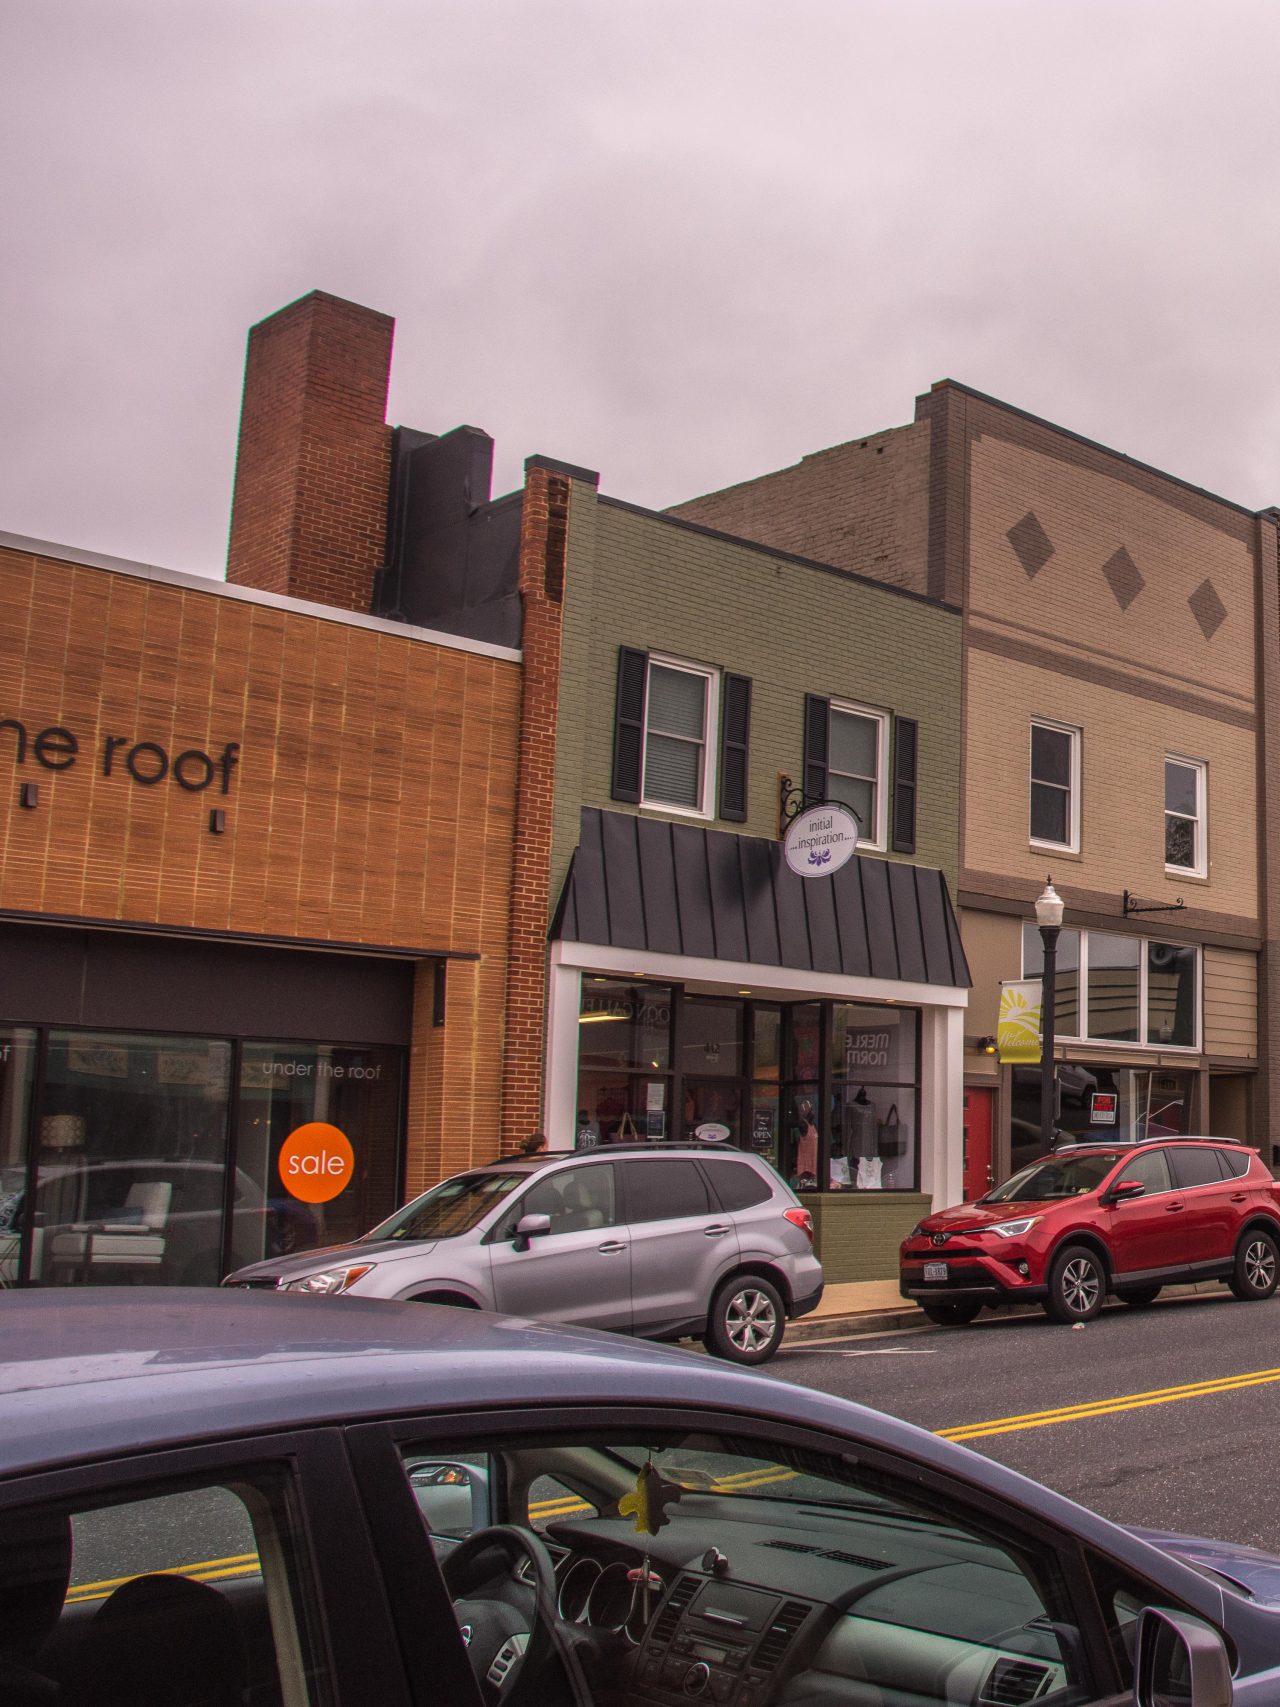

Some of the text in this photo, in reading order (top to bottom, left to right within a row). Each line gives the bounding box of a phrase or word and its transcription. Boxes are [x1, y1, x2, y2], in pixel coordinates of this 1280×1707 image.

[103, 736, 241, 795] roof
[809, 815, 833, 832] initial
[998, 1030, 1040, 1047] Welcome
[262, 1060, 382, 1080] under the roof
[753, 1131, 772, 1139] OPEN
[287, 1149, 345, 1175] sale
